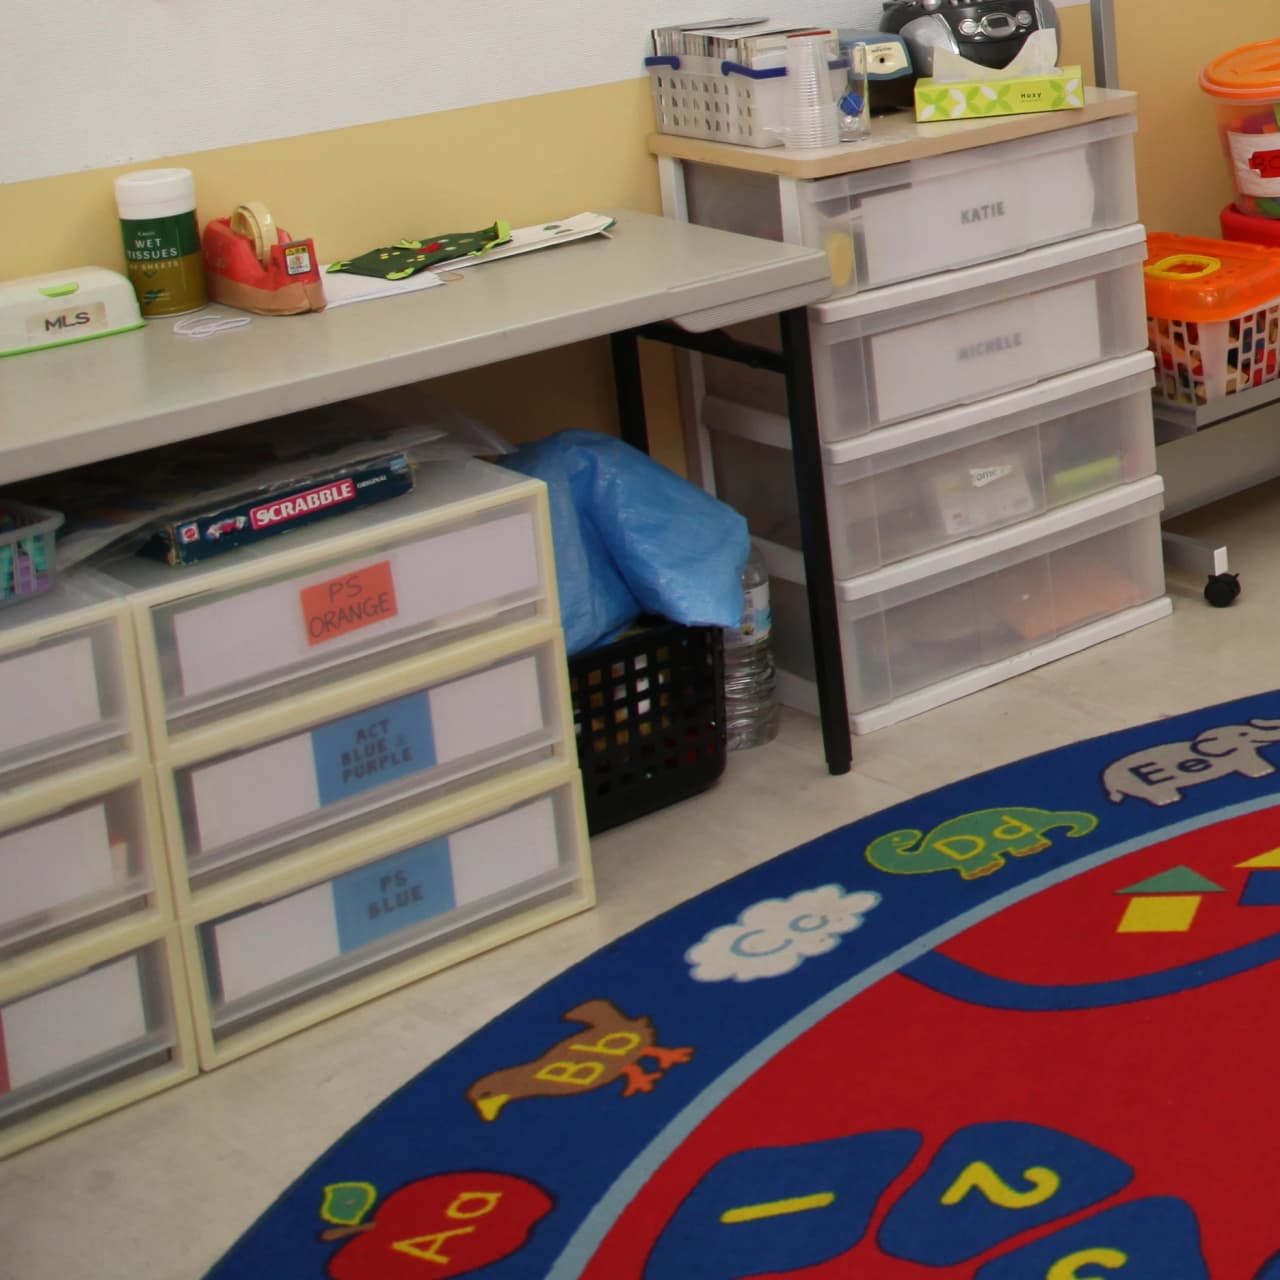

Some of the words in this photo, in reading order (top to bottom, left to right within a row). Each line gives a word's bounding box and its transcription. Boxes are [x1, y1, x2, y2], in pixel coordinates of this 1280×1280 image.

[960, 201, 1006, 225] KATIE
[127, 247, 178, 261] TISSUES
[134, 238, 162, 249] WET
[44, 311, 91, 332] MLS
[256, 482, 353, 526] SCRABBLE
[327, 575, 364, 602] PS
[309, 592, 392, 639] ORANGE
[355, 720, 391, 744] ACT
[341, 746, 414, 785] PURPLE
[1128, 757, 1213, 787] Ee
[931, 812, 1034, 862] Dd
[378, 870, 408, 895] PS
[367, 885, 425, 920] BLUE
[729, 910, 831, 958] Cc
[535, 1029, 640, 1088] Bb
[940, 1160, 1060, 1210] 2
[392, 1189, 502, 1266] Aa
